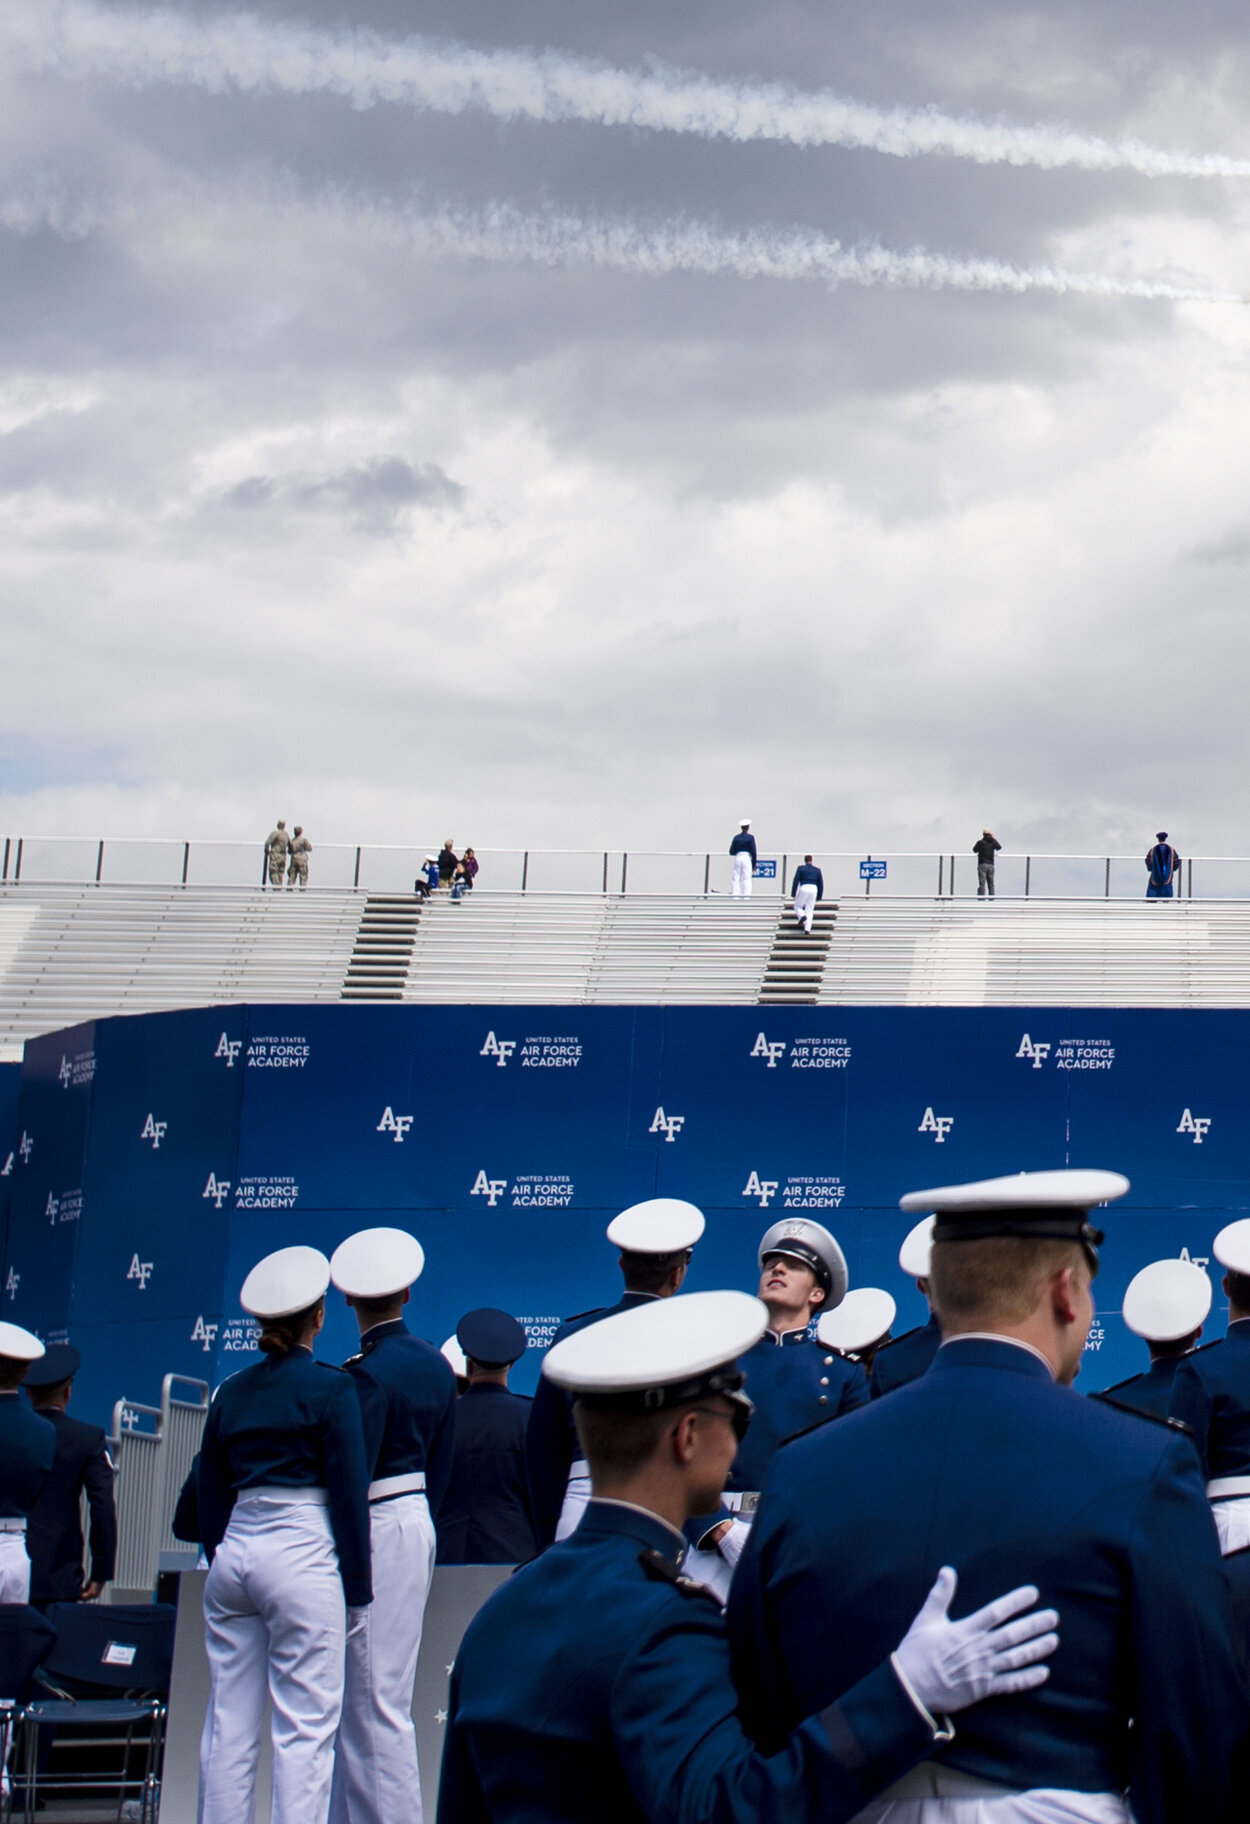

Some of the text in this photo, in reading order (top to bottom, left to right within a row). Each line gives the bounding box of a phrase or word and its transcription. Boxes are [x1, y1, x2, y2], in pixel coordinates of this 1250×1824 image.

[753, 869, 774, 877] M-21
[861, 869, 885, 877] M-22
[215, 1032, 242, 1067] AF
[247, 1046, 310, 1056] AIR FORCE
[480, 1031, 516, 1066] AF
[520, 1046, 583, 1056] AIR FORCE
[750, 1032, 786, 1067] AF
[791, 1048, 851, 1057] AIR FORCE
[1015, 1034, 1050, 1068] AF
[1054, 1049, 1115, 1058] AIR FORCE
[248, 1057, 307, 1067] ACADEMY
[522, 1057, 580, 1067] ACADEMY
[792, 1059, 849, 1068] ACADEMY
[1056, 1059, 1112, 1069] ACADEMY
[60, 1054, 73, 1089] AF
[377, 1106, 413, 1142] AF
[649, 1106, 684, 1142] AF
[918, 1106, 954, 1142] AF
[1176, 1108, 1211, 1143] AF
[141, 1113, 167, 1148] AF
[20, 1130, 33, 1164] AF
[202, 1172, 231, 1208] AF
[235, 1186, 299, 1196] AIR FORCE
[470, 1170, 507, 1206] AF
[511, 1185, 574, 1194] AIR FORCE
[742, 1171, 779, 1207] AF
[783, 1186, 846, 1196] AIR FORCE
[236, 1198, 296, 1208] ACADEMY
[513, 1196, 571, 1206] ACADEMY
[784, 1198, 842, 1207] ACADEMY
[46, 1191, 60, 1226] AF
[126, 1253, 153, 1290] AF
[6, 1265, 20, 1300] AF
[190, 1315, 218, 1352] AF
[222, 1329, 244, 1339] AIR
[525, 1326, 557, 1336] FORC
[224, 1340, 258, 1351] ACAD
